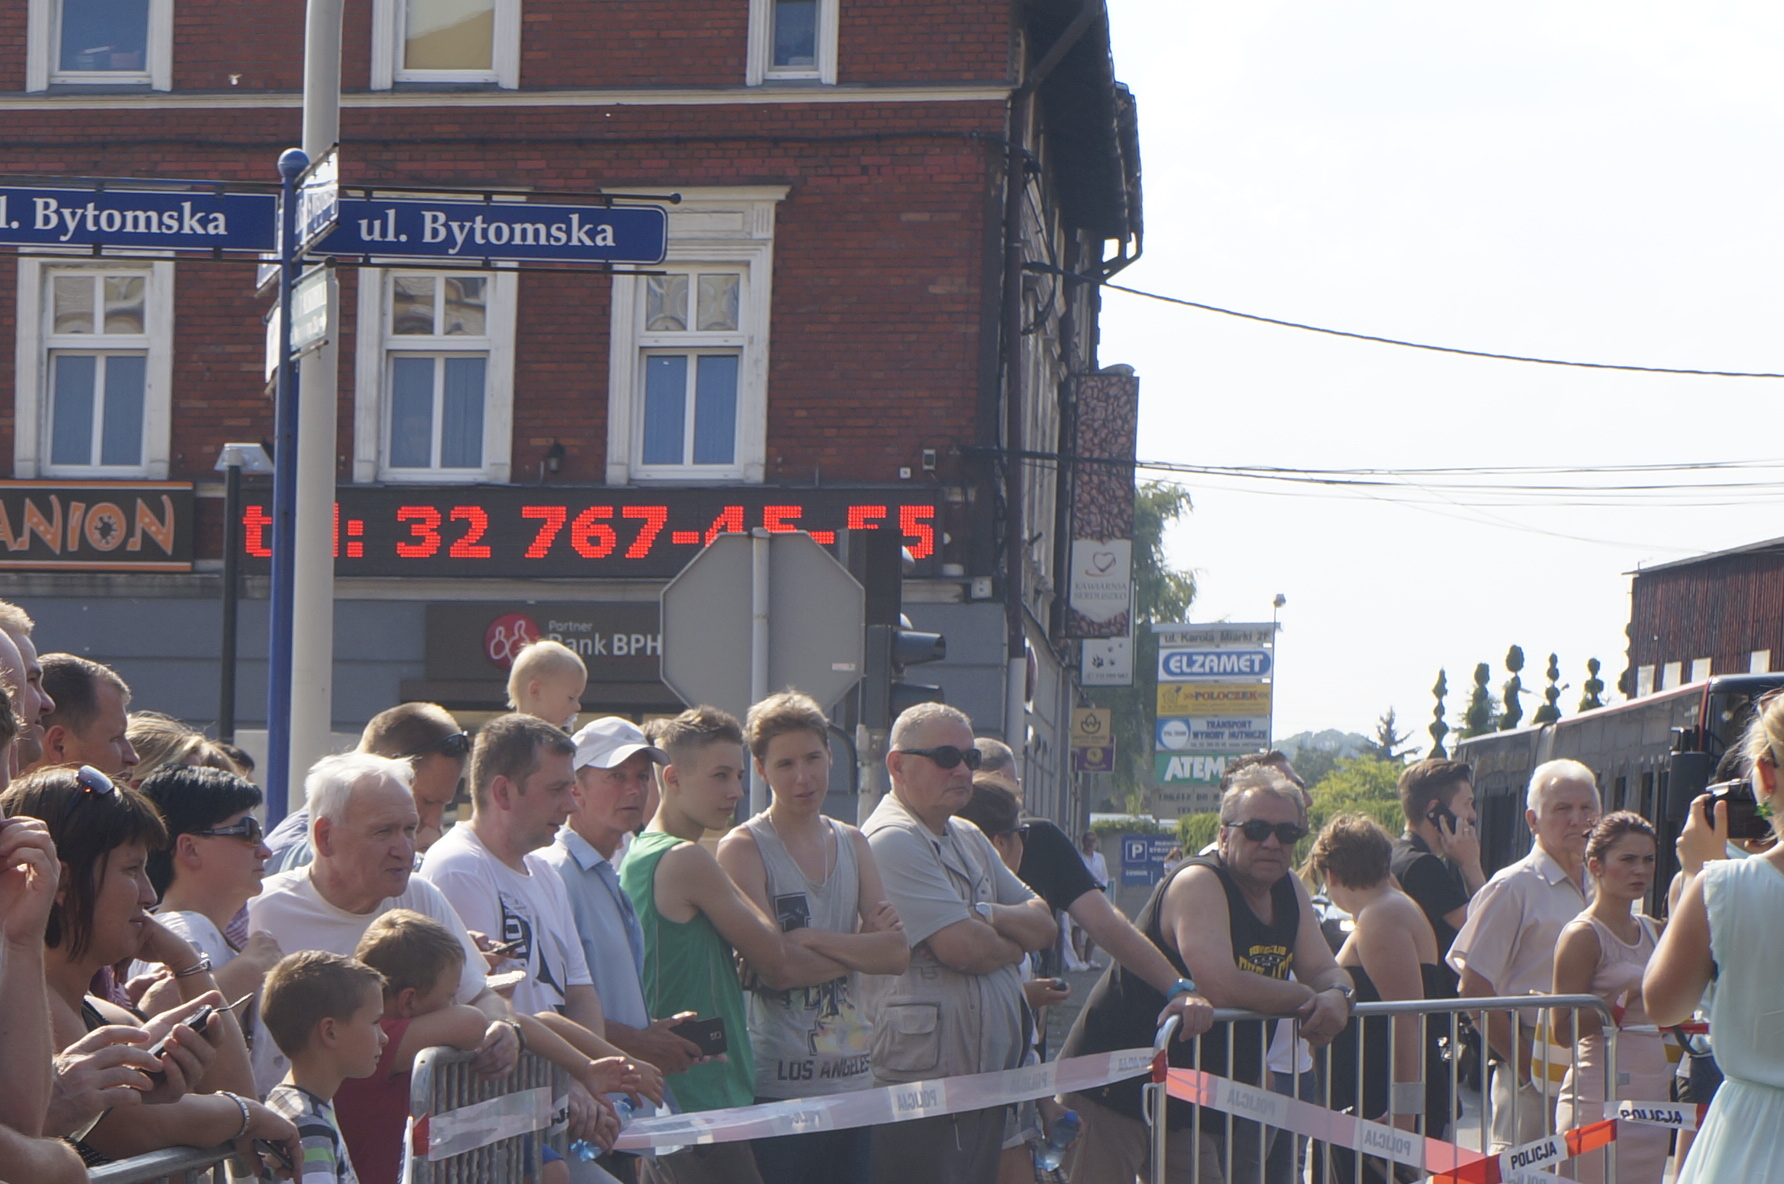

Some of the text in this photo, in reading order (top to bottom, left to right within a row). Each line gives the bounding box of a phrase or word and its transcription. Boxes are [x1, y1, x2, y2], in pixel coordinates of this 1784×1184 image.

[33, 197, 228, 242] Bytomska
[358, 208, 408, 243] ul.
[421, 211, 616, 254] Bytomska
[242, 503, 365, 558] tl:
[396, 504, 493, 559] 32
[548, 619, 594, 632] Partner
[612, 633, 662, 657] BPH
[1168, 653, 1265, 674] ELZAMET
[1194, 690, 1258, 701] POLOCZEK
[1192, 730, 1225, 740] WYROBY
[1228, 730, 1267, 739] HUTNICZE
[1206, 720, 1253, 730] TRANSPORT
[777, 1053, 872, 1081] LOS ANGELES
[1510, 1141, 1558, 1171] POLICJA
